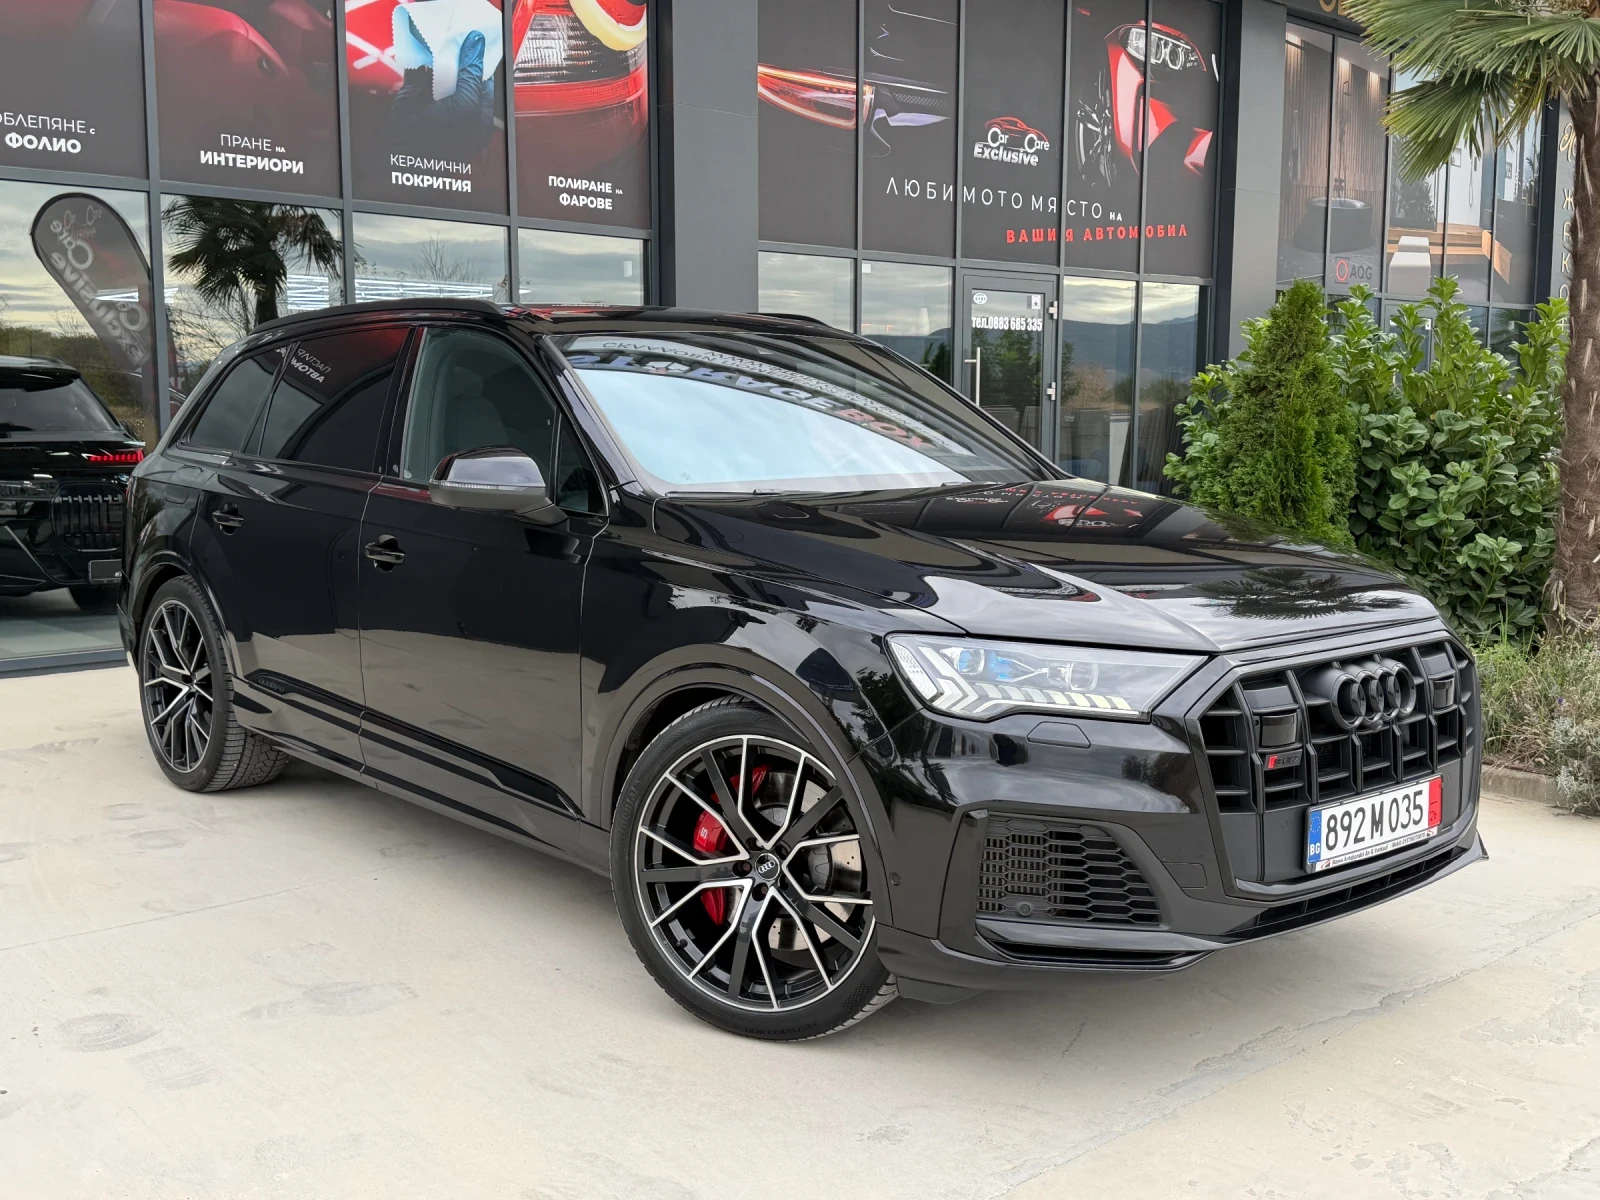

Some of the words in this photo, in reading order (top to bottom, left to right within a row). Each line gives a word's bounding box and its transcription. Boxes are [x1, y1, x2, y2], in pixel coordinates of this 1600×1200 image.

[0, 112, 86, 133] БЛЕПЯНЕ
[5, 132, 81, 153] ФОЛИО
[220, 134, 272, 151] ПРАНЕ
[987, 127, 1010, 148] Car
[1023, 132, 1050, 154] Care
[200, 150, 304, 174] ИНТЕРИОРИ
[390, 153, 472, 175] КЕРАМИЧНИ
[973, 143, 1040, 167] Exclusive
[391, 171, 472, 193] ПОКРИТИЯ
[548, 175, 612, 194] ПОЛИРАНЕ
[558, 192, 613, 210] ФАРОВЕ
[886, 176, 1022, 209] ЛЮБИМОТО
[1031, 194, 1103, 219] МЯСТО
[1109, 211, 1123, 222] НА
[1006, 228, 1074, 244] ВАШИЯ
[1083, 224, 1188, 241] АВТОМОБИЛ
[1349, 263, 1373, 280] AQG
[1010, 316, 1026, 331] 685
[1026, 317, 1043, 332] 335
[1325, 806, 1366, 851] 892
[1370, 800, 1384, 840] M
[1388, 789, 1424, 833] 035
[1309, 842, 1321, 856] BG
